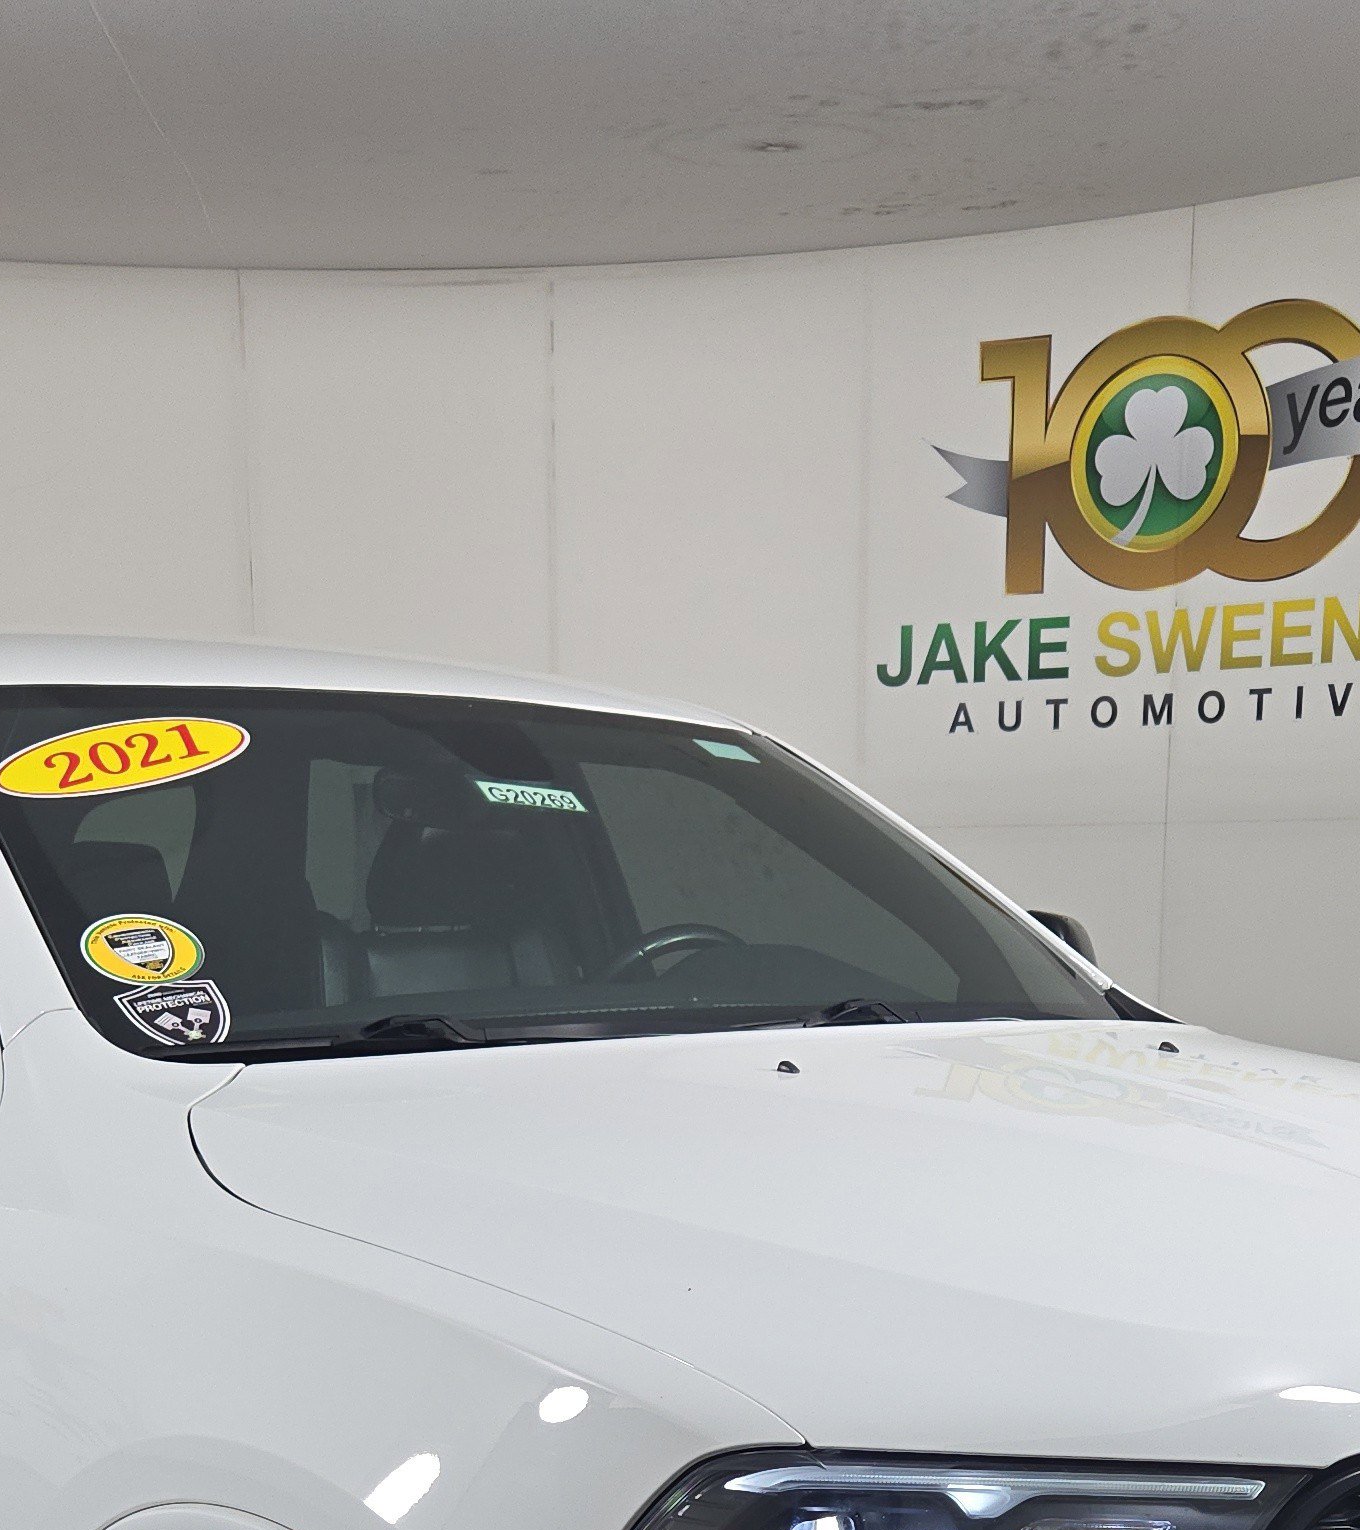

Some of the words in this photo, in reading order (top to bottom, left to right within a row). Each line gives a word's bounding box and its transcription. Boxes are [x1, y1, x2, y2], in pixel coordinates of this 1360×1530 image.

[876, 615, 1070, 687] JAKE
[43, 723, 212, 790] 2021
[488, 786, 577, 810] G20269
[136, 994, 211, 1014] PROTECTION
